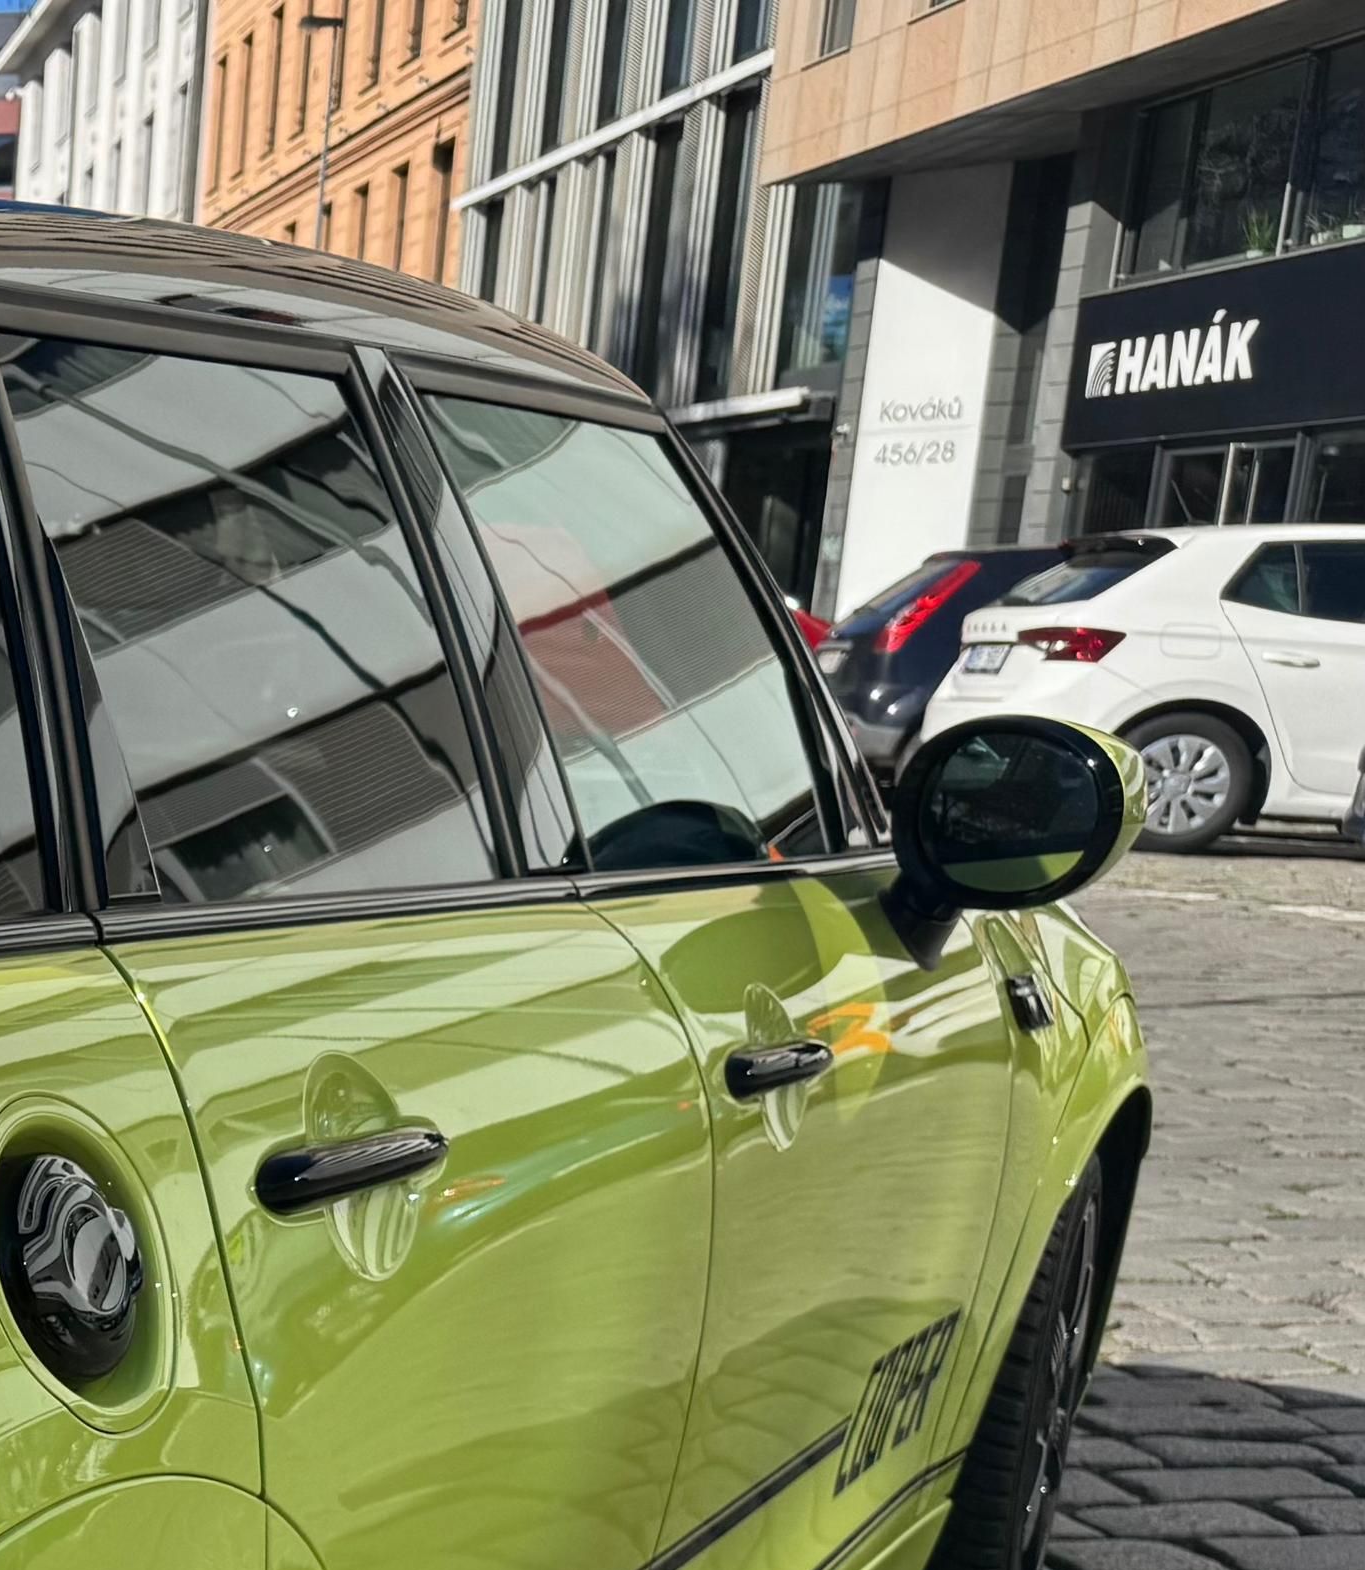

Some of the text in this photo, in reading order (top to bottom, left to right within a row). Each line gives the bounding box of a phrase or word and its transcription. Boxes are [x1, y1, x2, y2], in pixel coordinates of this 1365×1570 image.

[1114, 308, 1260, 395] HANÁK
[879, 395, 962, 422] Kováků
[873, 439, 955, 466] 456/28
